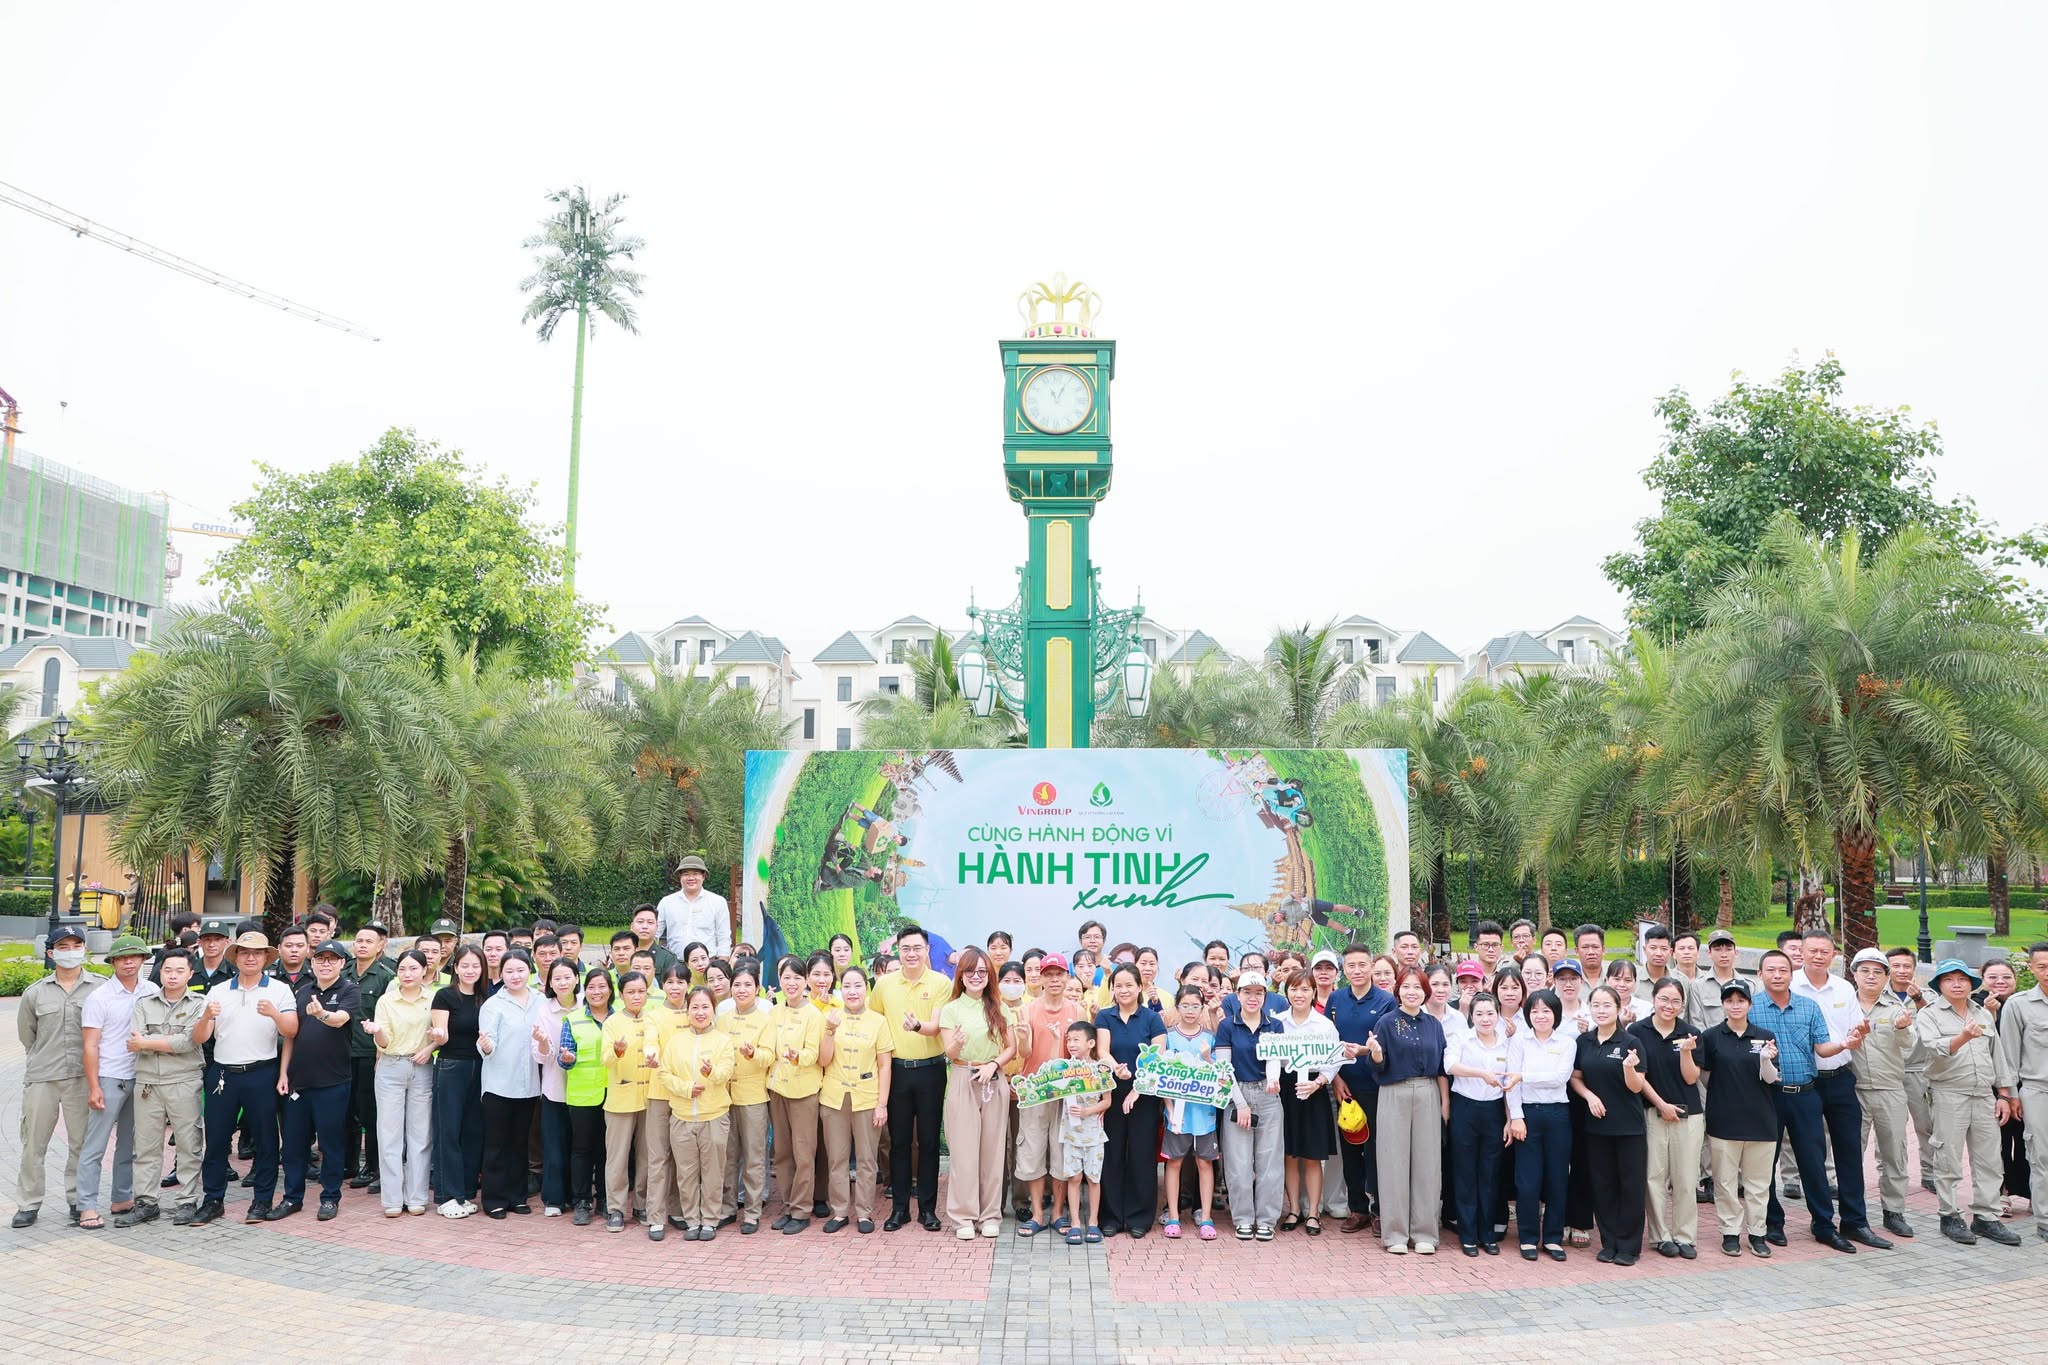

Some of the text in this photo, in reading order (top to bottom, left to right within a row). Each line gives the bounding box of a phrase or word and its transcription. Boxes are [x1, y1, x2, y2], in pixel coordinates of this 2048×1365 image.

[1017, 805, 1072, 816] VINGROUP
[967, 823, 1173, 846] CÙNG HÀNH ĐỘNG VÌ
[958, 843, 1181, 885] HÀNH TINH
[1259, 1042, 1335, 1057] HÀNH TINH
